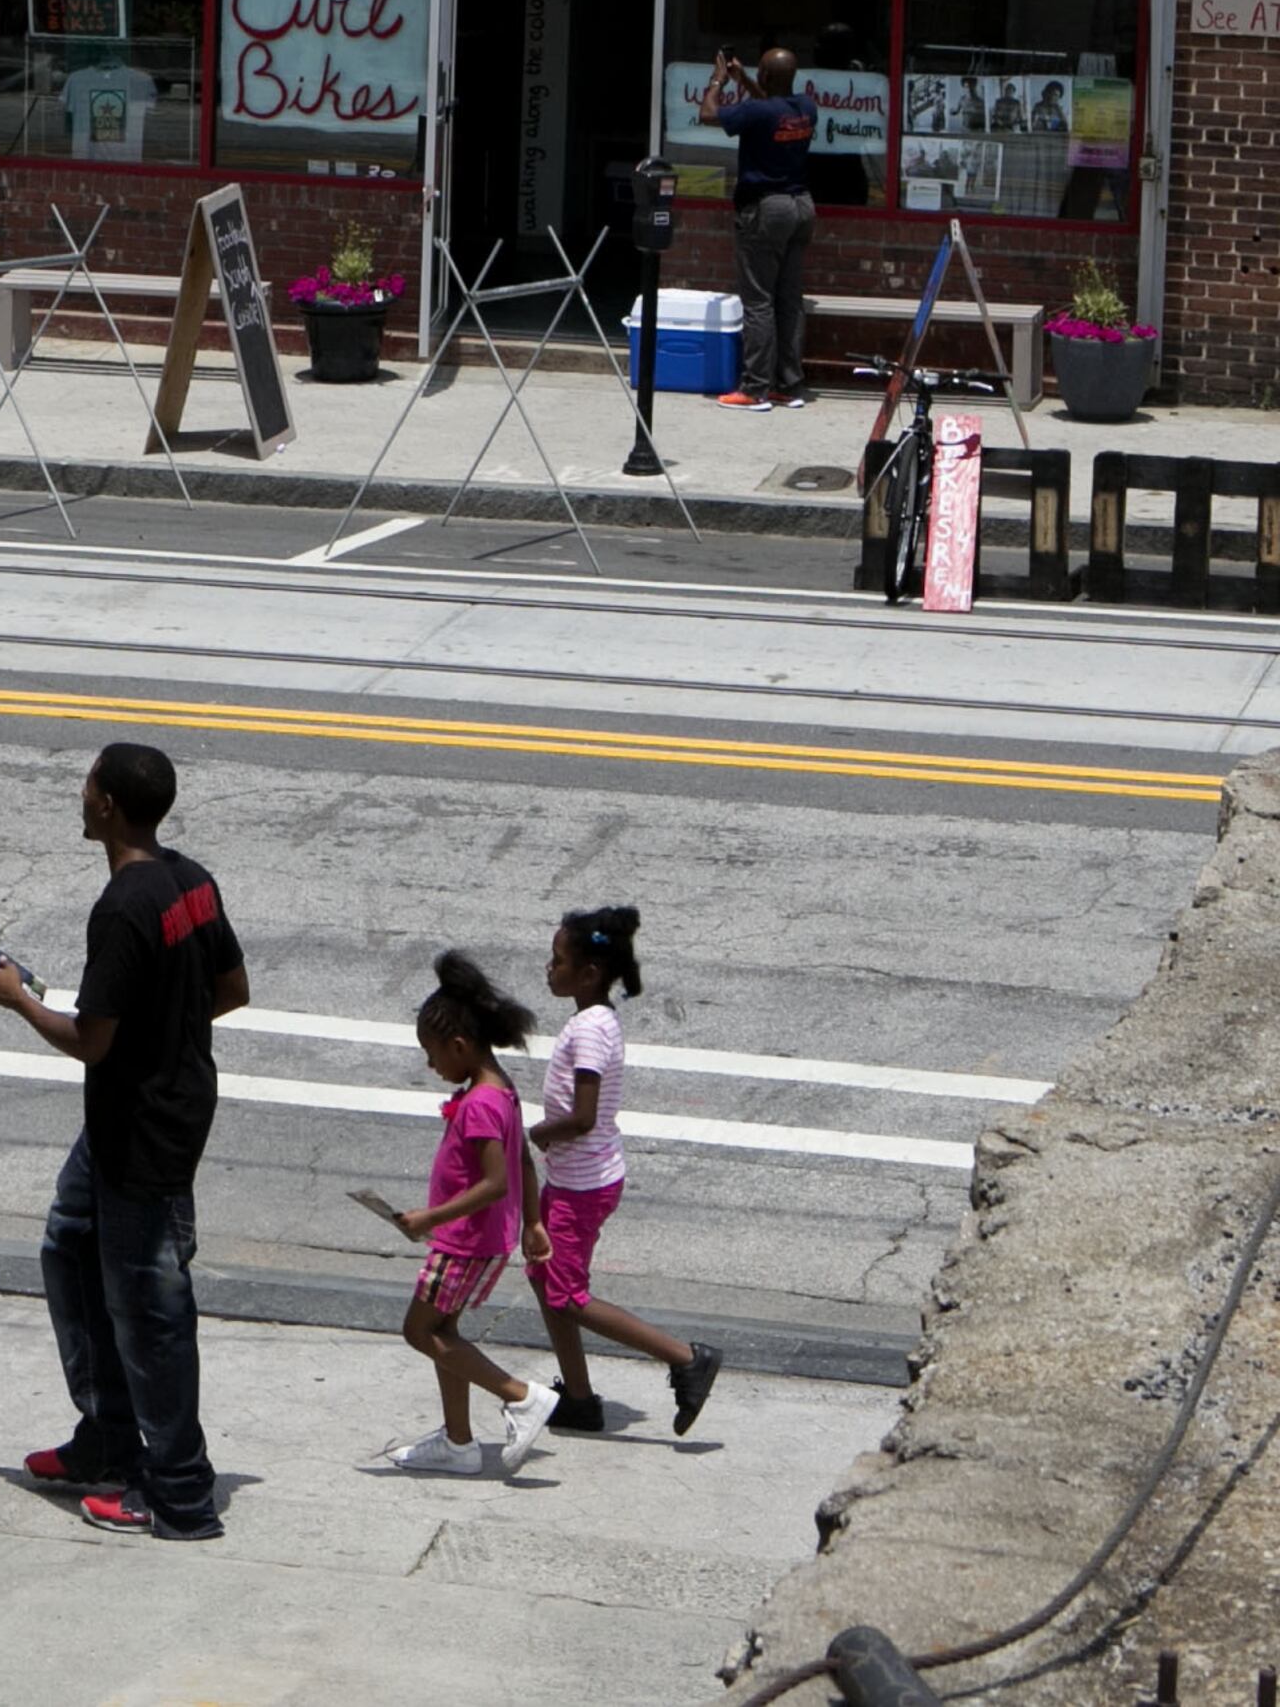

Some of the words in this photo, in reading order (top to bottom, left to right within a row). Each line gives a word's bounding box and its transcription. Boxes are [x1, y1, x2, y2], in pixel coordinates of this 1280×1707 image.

[1196, 0, 1238, 31] See
[233, 40, 420, 120] Bikes
[521, 84, 550, 139] along
